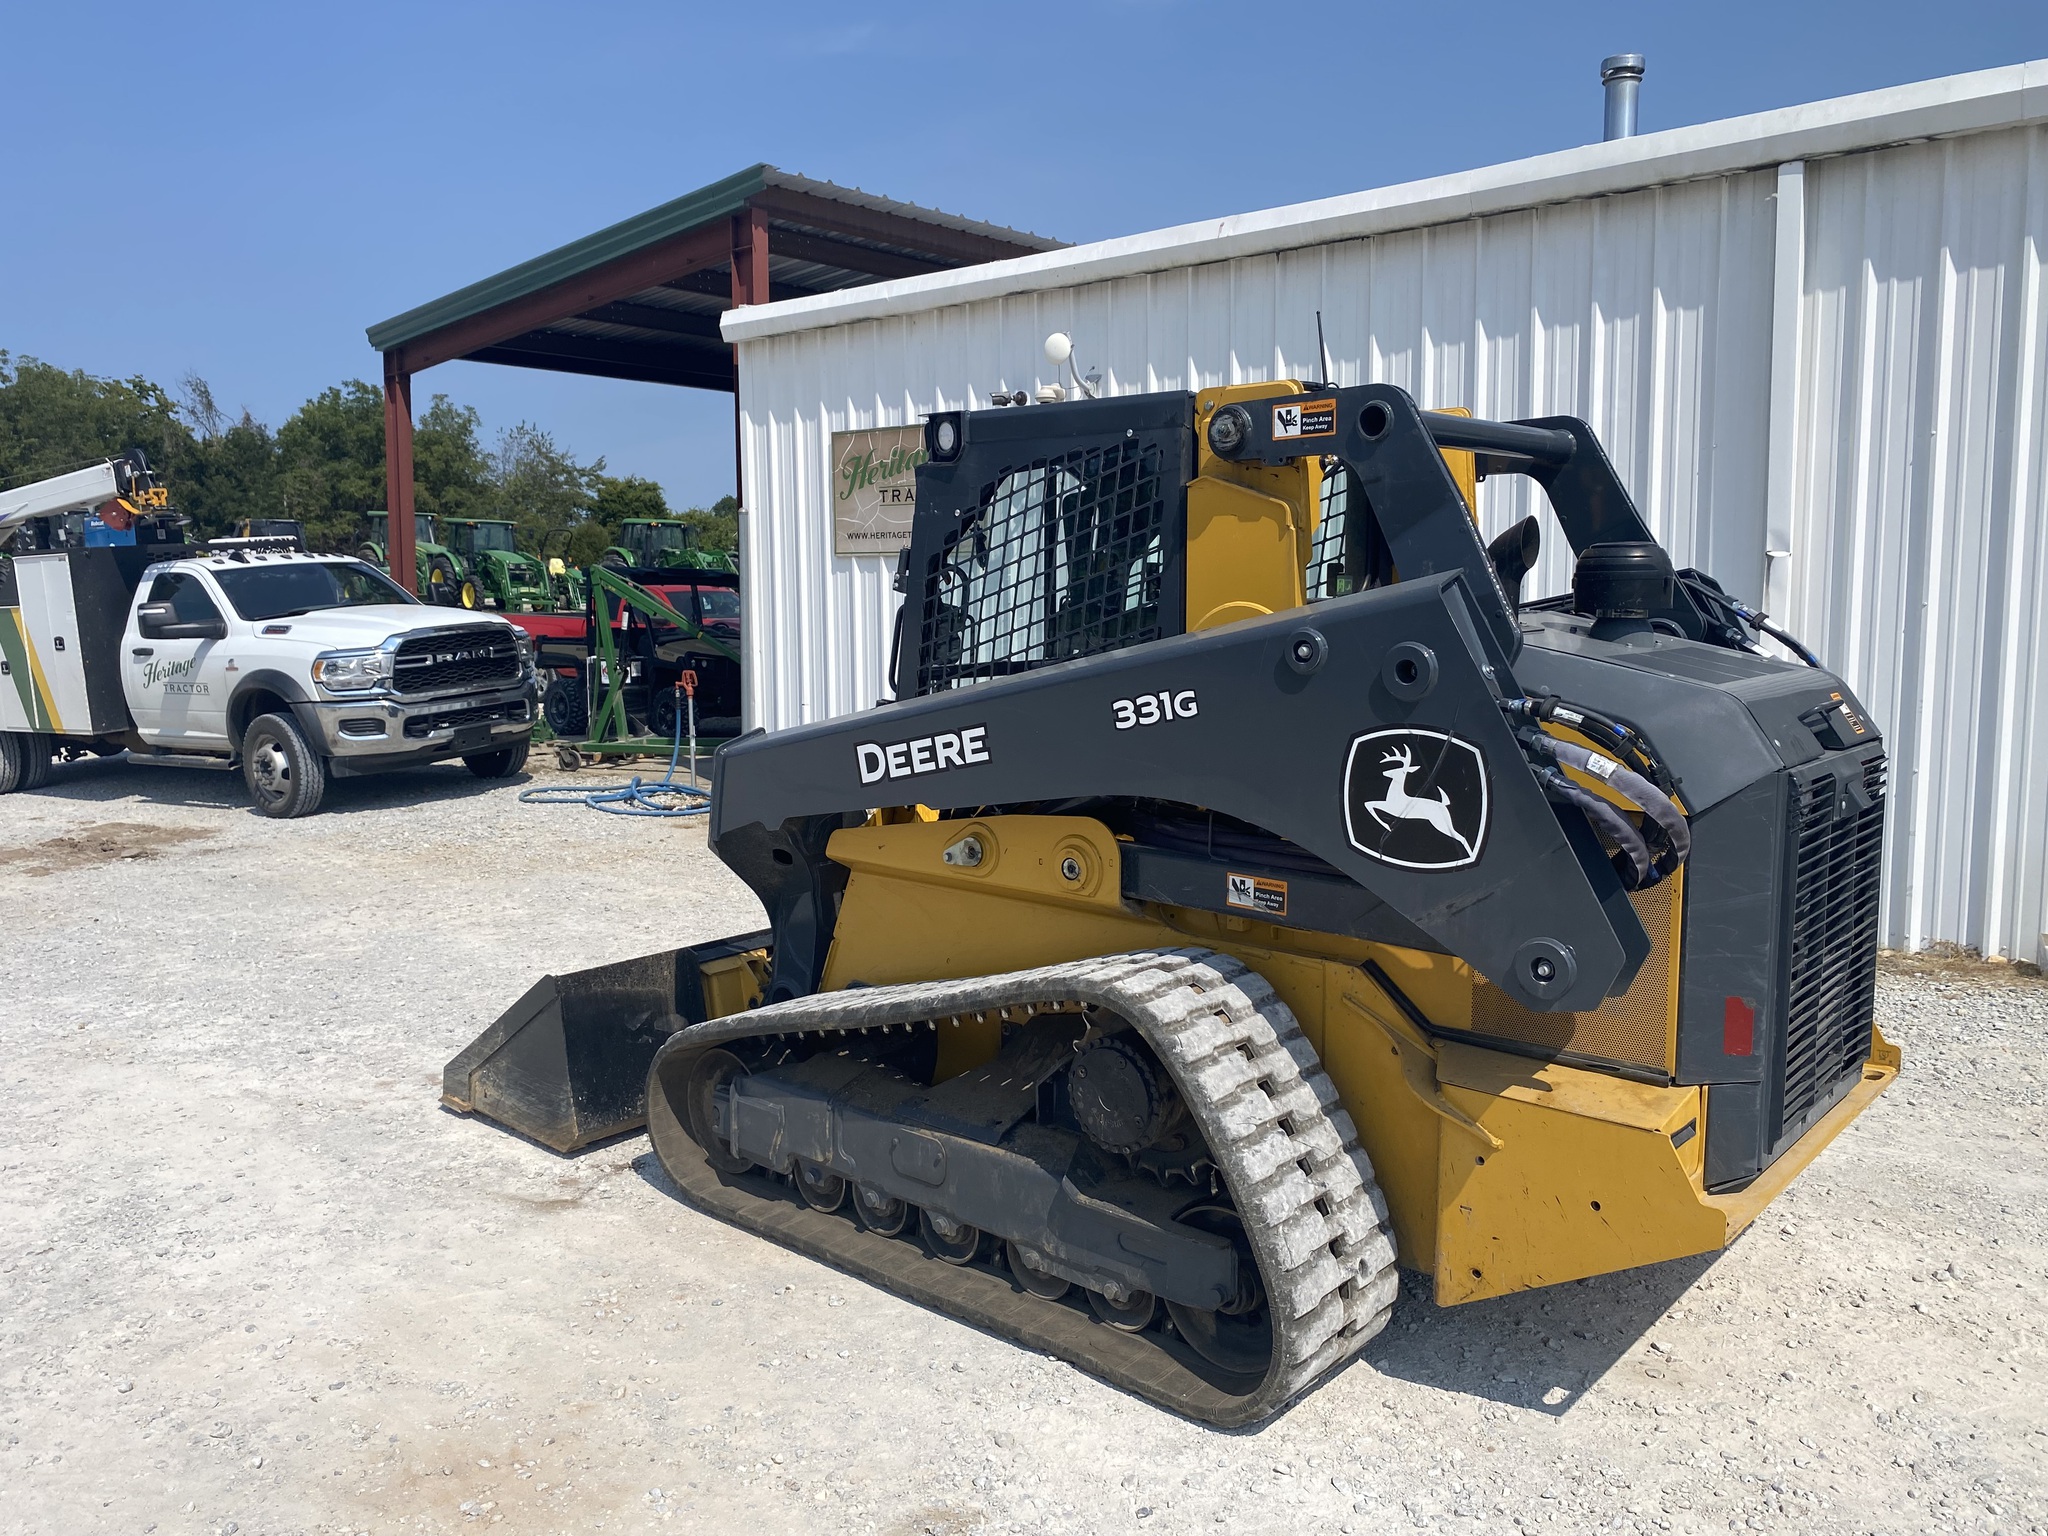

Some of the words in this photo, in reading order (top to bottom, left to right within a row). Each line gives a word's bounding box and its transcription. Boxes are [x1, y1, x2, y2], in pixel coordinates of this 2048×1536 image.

[879, 488, 915, 503] TRA
[436, 649, 487, 663] RAM
[143, 657, 197, 689] Heritage
[163, 684, 209, 693] TRACTOR
[1112, 690, 1199, 729] 331G
[856, 726, 990, 784] DEERE
[1255, 891, 1270, 899] Pinch
